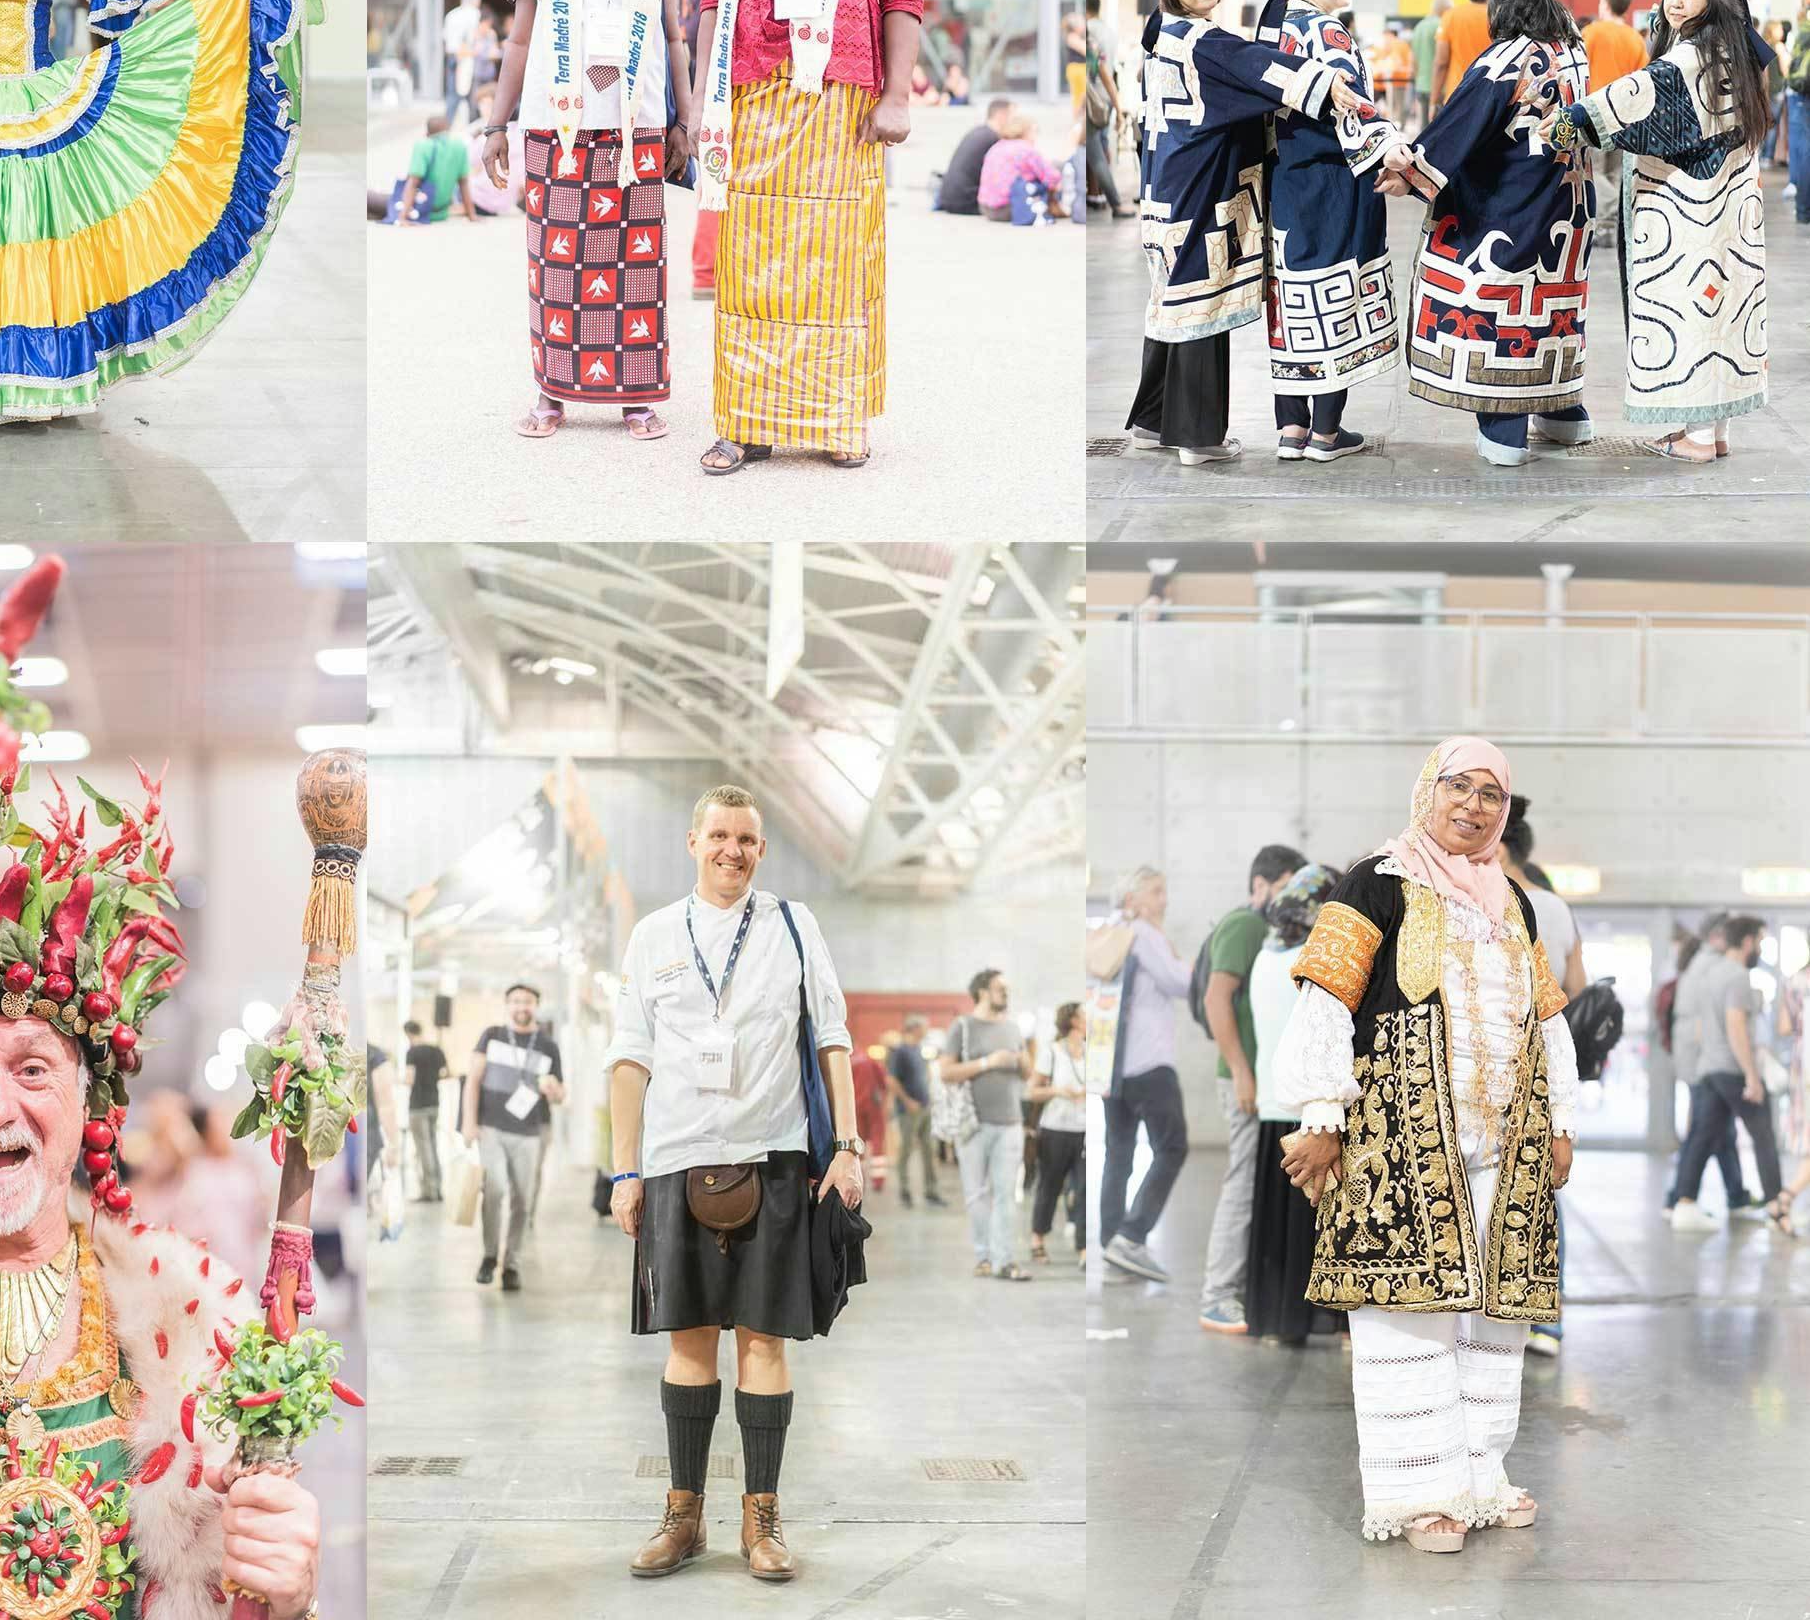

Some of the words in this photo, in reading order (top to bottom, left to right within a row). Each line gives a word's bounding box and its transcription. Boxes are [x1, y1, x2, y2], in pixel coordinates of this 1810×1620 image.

[631, 11, 648, 41] 2018
[721, 2, 732, 30] 2018
[553, 18, 570, 53] Madré
[717, 32, 729, 70] Madré
[555, 55, 570, 85] Terra
[713, 72, 727, 103] Terra
